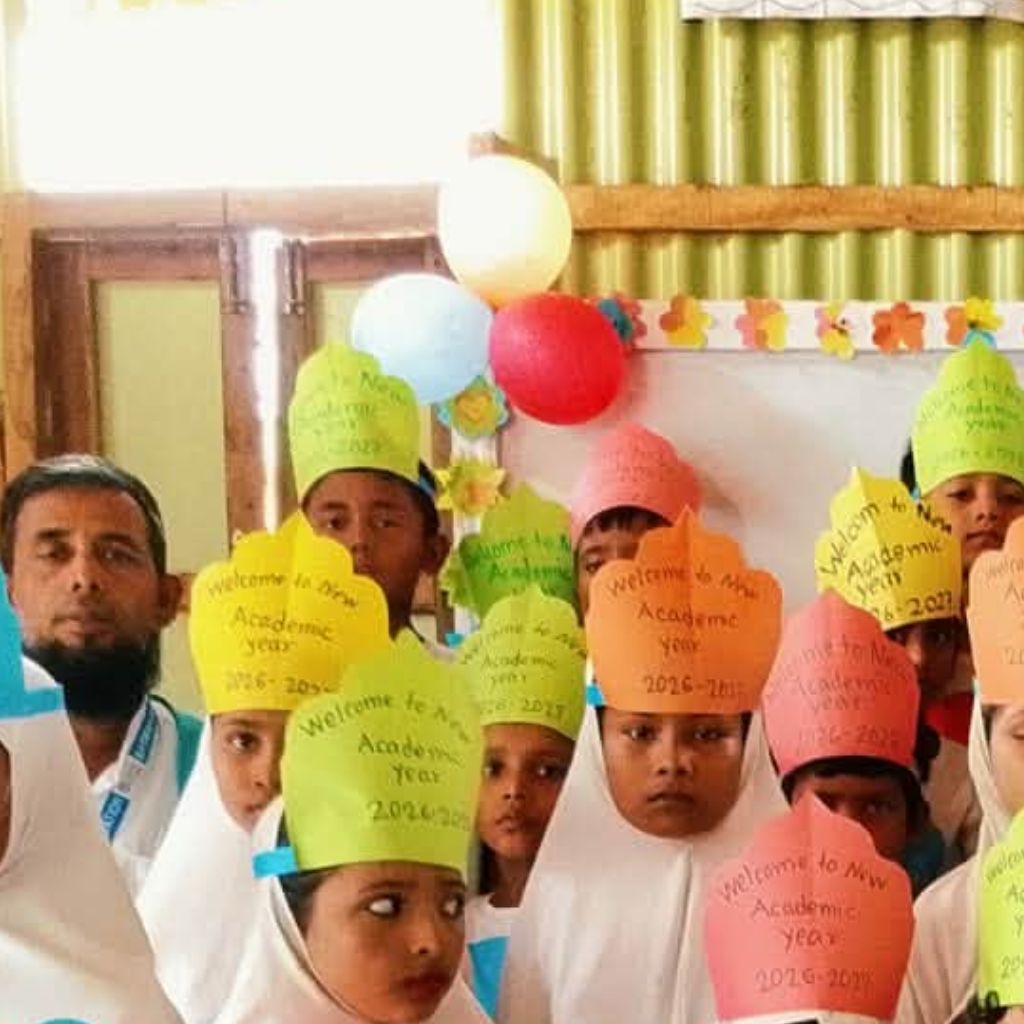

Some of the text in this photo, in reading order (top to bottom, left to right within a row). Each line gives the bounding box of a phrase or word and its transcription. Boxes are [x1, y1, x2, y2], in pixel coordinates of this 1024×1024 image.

[299, 692, 393, 738] Welcome
[718, 851, 889, 903] Welcome to New
[750, 893, 859, 922] Academic
